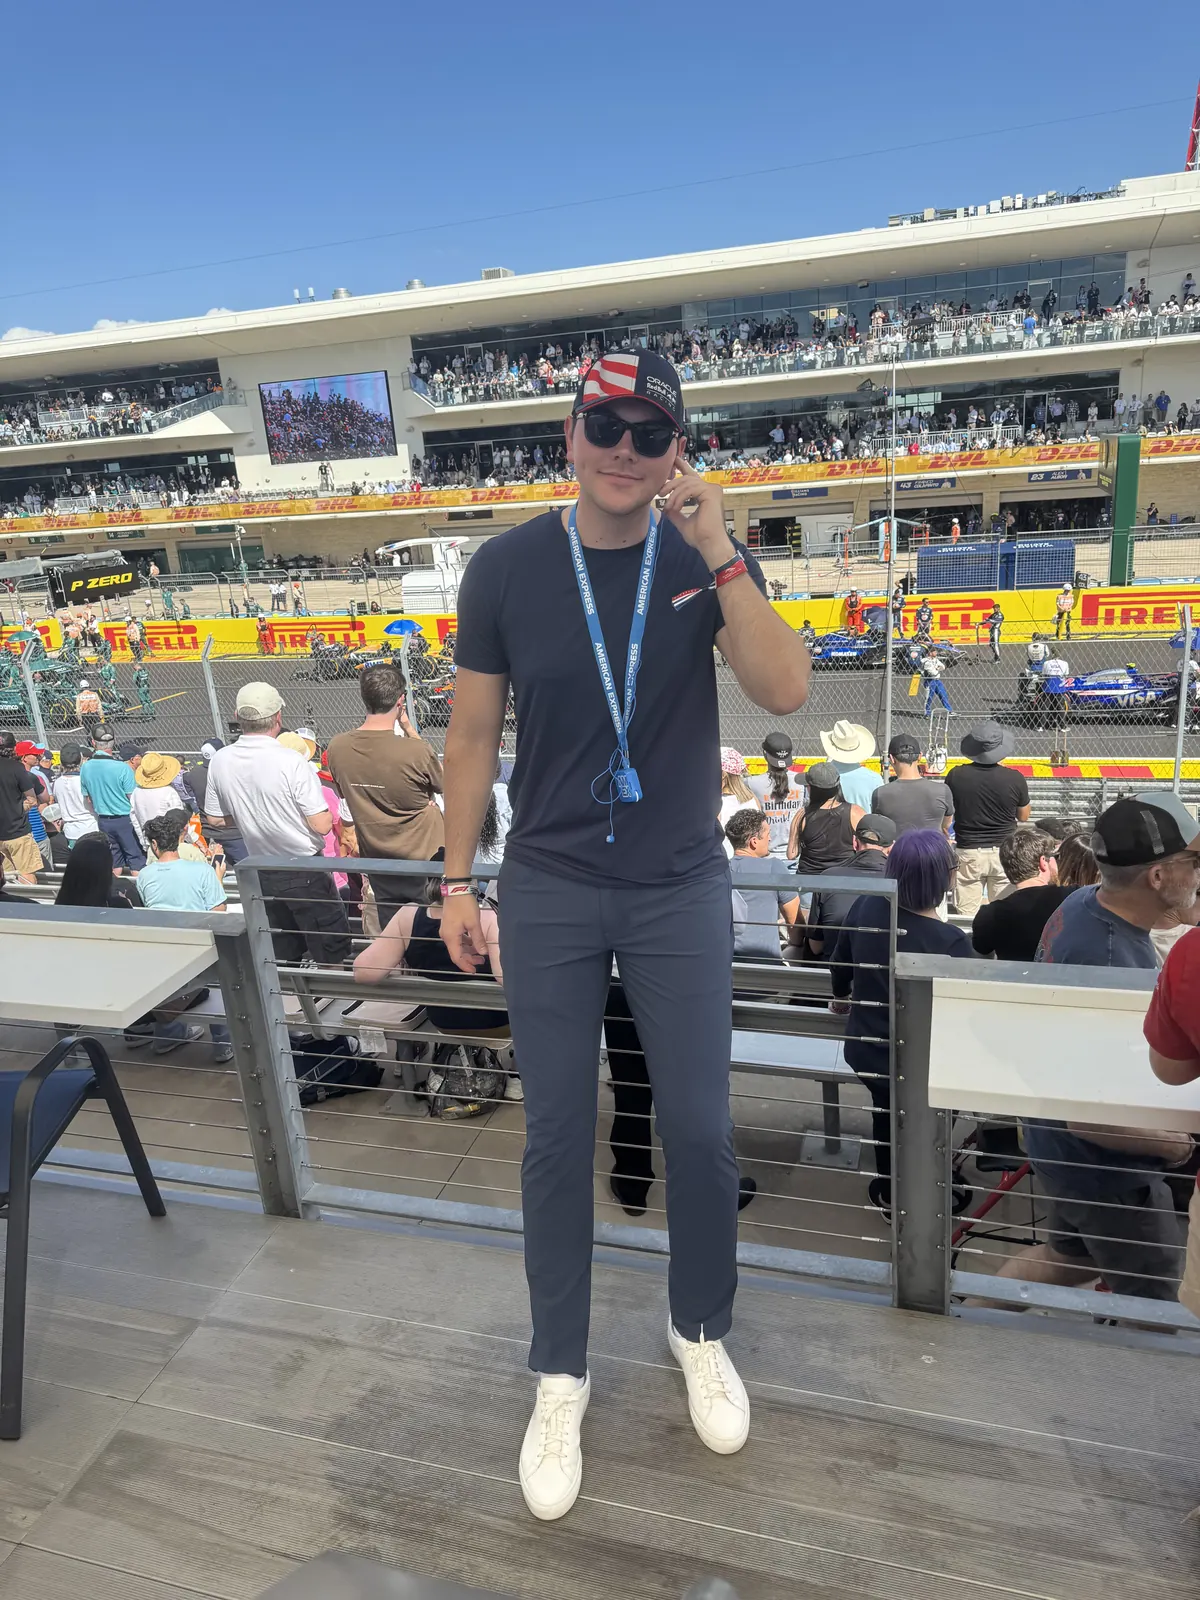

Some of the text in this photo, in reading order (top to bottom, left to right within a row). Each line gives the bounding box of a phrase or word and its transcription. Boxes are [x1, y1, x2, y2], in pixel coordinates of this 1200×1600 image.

[646, 376, 677, 398] ORACLE
[1035, 444, 1099, 462] DHL
[1148, 438, 1200, 454] DH
[826, 461, 883, 477] DHL
[928, 453, 989, 469] DHL
[730, 467, 785, 484] DHL
[471, 488, 517, 502] DHL
[552, 484, 580, 497] DH
[315, 498, 358, 510] DHL
[391, 493, 436, 507] DHL
[174, 507, 213, 519] DHL
[242, 502, 284, 515] DHL
[107, 511, 144, 524] DHL
[569, 526, 595, 615] AMERICAN EXPRESS
[636, 526, 656, 615] AMERICAN EXPRESS
[70, 572, 133, 592] P ZERO
[103, 625, 199, 651] PIELLI
[595, 642, 612, 690] AMERICAN
[1117, 689, 1157, 707] VISA
